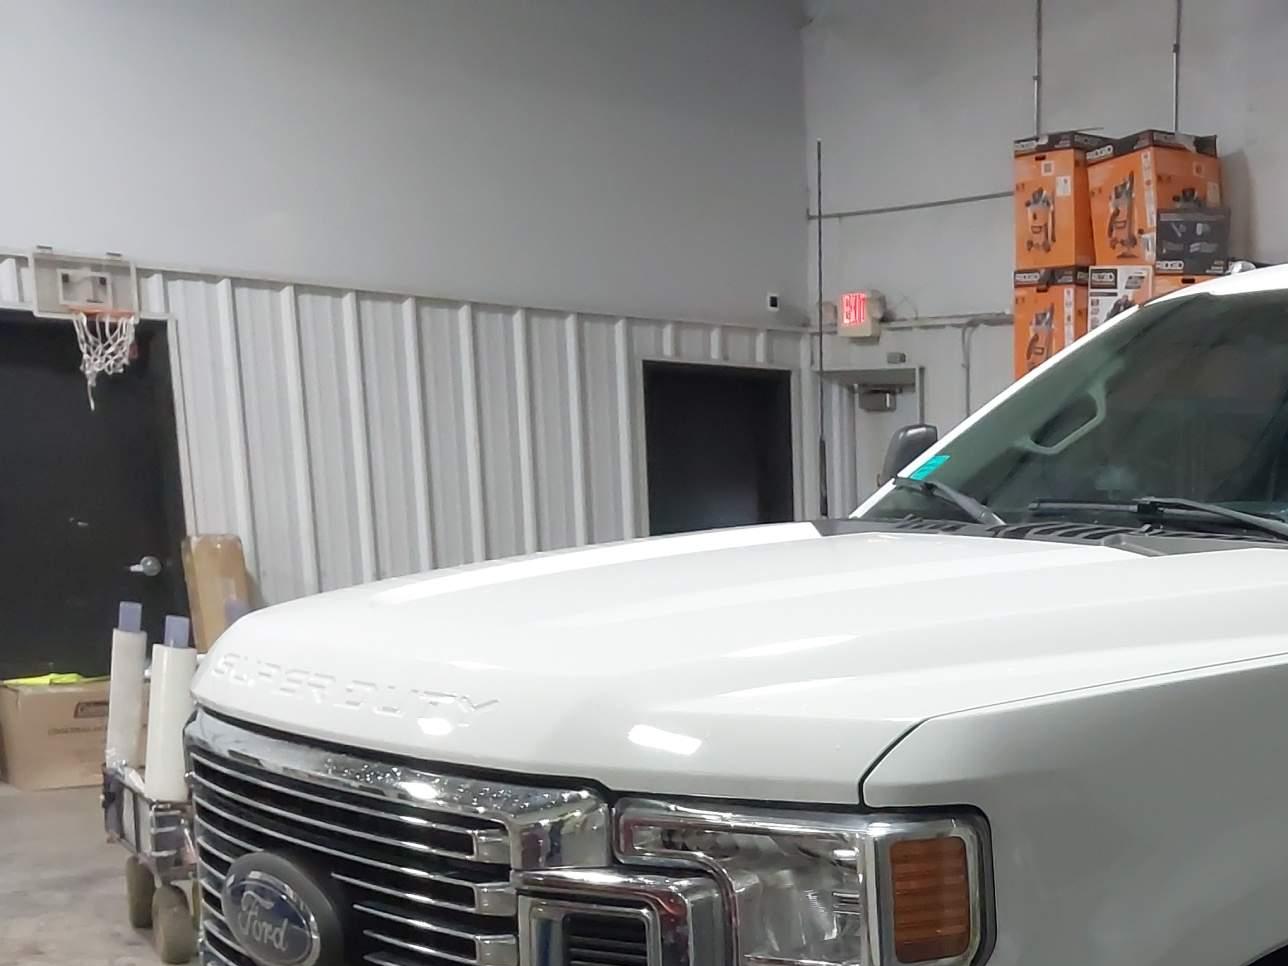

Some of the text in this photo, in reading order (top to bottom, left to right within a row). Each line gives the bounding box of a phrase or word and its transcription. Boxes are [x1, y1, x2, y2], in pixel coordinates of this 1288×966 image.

[843, 293, 865, 324] EXIT
[212, 652, 499, 730] SUPER DUTY
[237, 889, 289, 953] Ford
